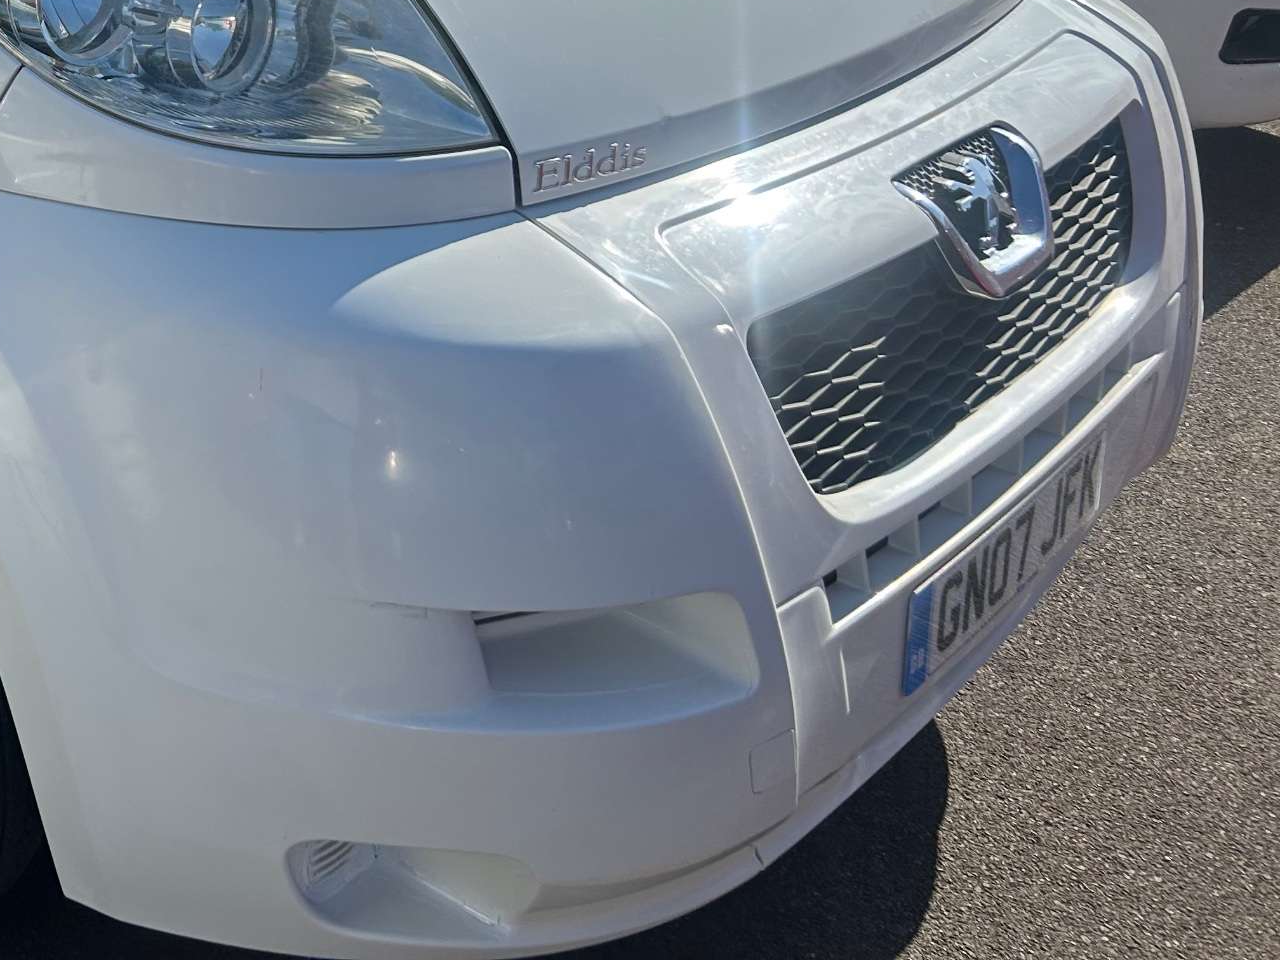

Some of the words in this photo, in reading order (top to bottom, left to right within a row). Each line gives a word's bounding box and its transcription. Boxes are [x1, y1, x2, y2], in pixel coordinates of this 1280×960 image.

[534, 142, 647, 192] Elddis
[937, 501, 1036, 652] GN07
[1041, 439, 1103, 556] JFK
